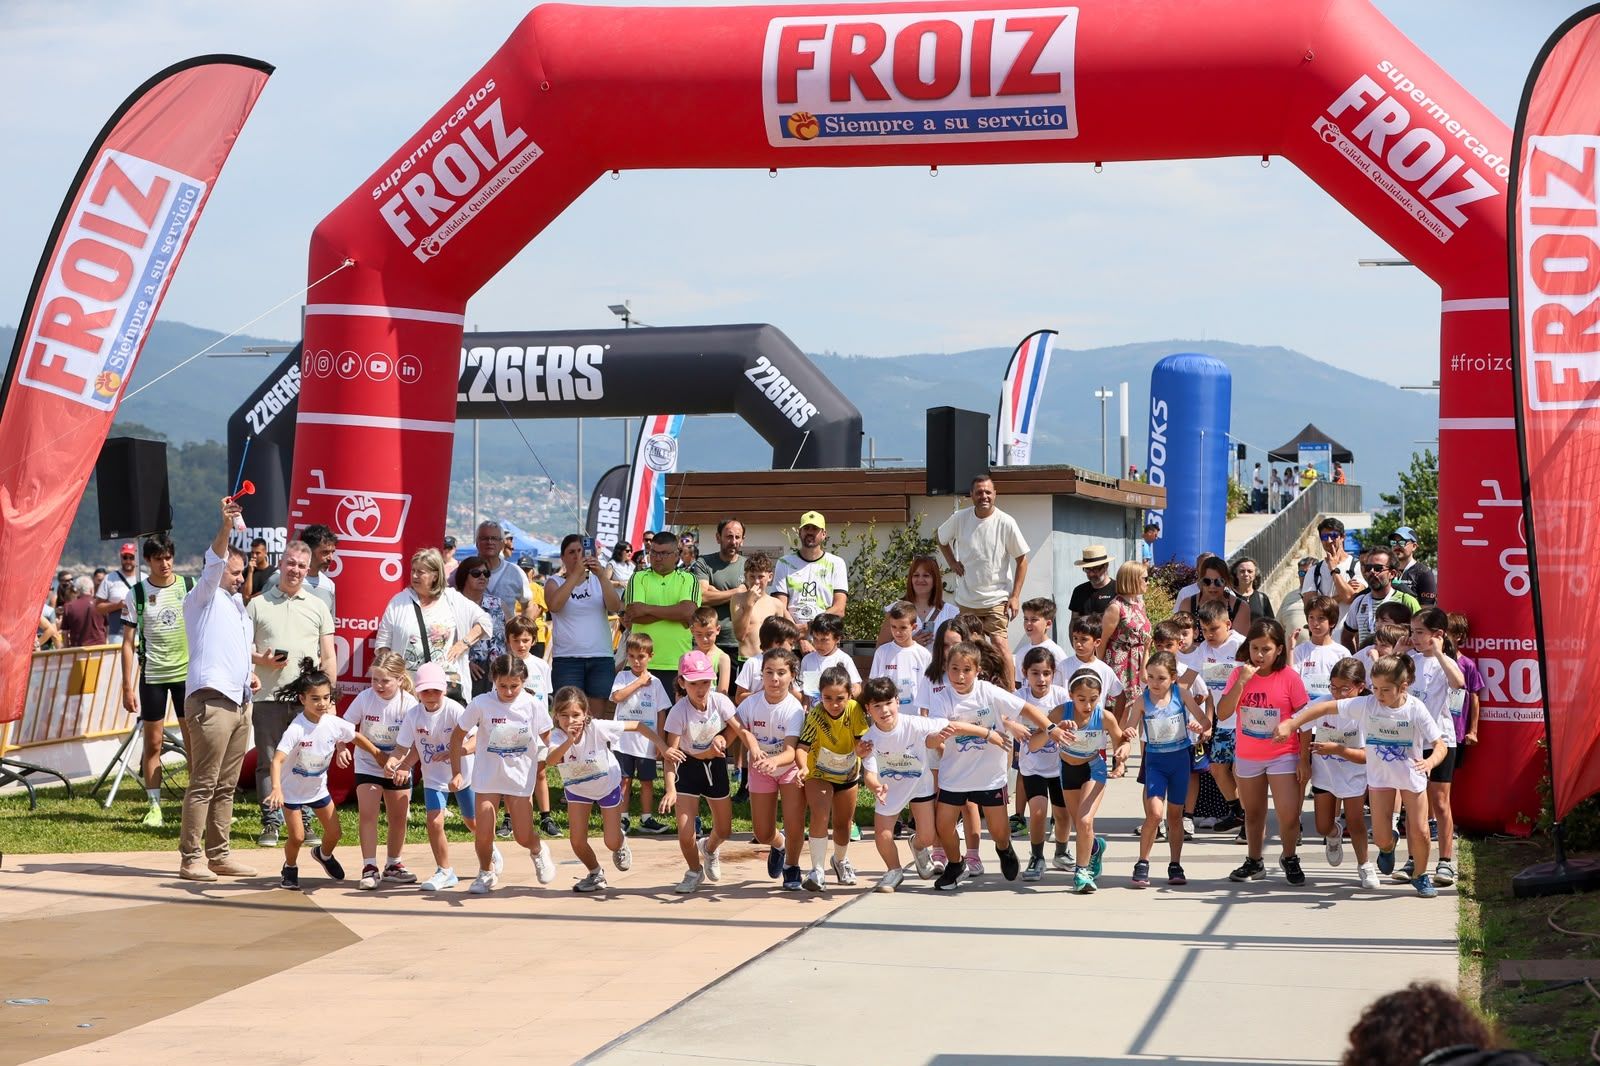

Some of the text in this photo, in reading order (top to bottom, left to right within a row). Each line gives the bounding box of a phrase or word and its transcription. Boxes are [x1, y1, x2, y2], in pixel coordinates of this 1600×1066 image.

[776, 14, 1069, 104] FROIZ
[371, 78, 496, 201] supermercados
[378, 97, 528, 248] FROIZ
[825, 109, 1064, 136] Siempre a su servicio
[1326, 73, 1500, 229] FROIZ
[1376, 59, 1510, 184] supermercado
[437, 147, 539, 241] Calidad, Qualidade, Quality
[1338, 139, 1448, 240] Calidad, Qualidade, Quality
[25, 156, 171, 396] FROIZ
[109, 187, 197, 370] Siempre a su servicio
[1528, 145, 1600, 403] FROIZ
[245, 364, 301, 436] 226ERS
[744, 356, 817, 429] 226ERS
[1147, 396, 1168, 540] BOOKS
